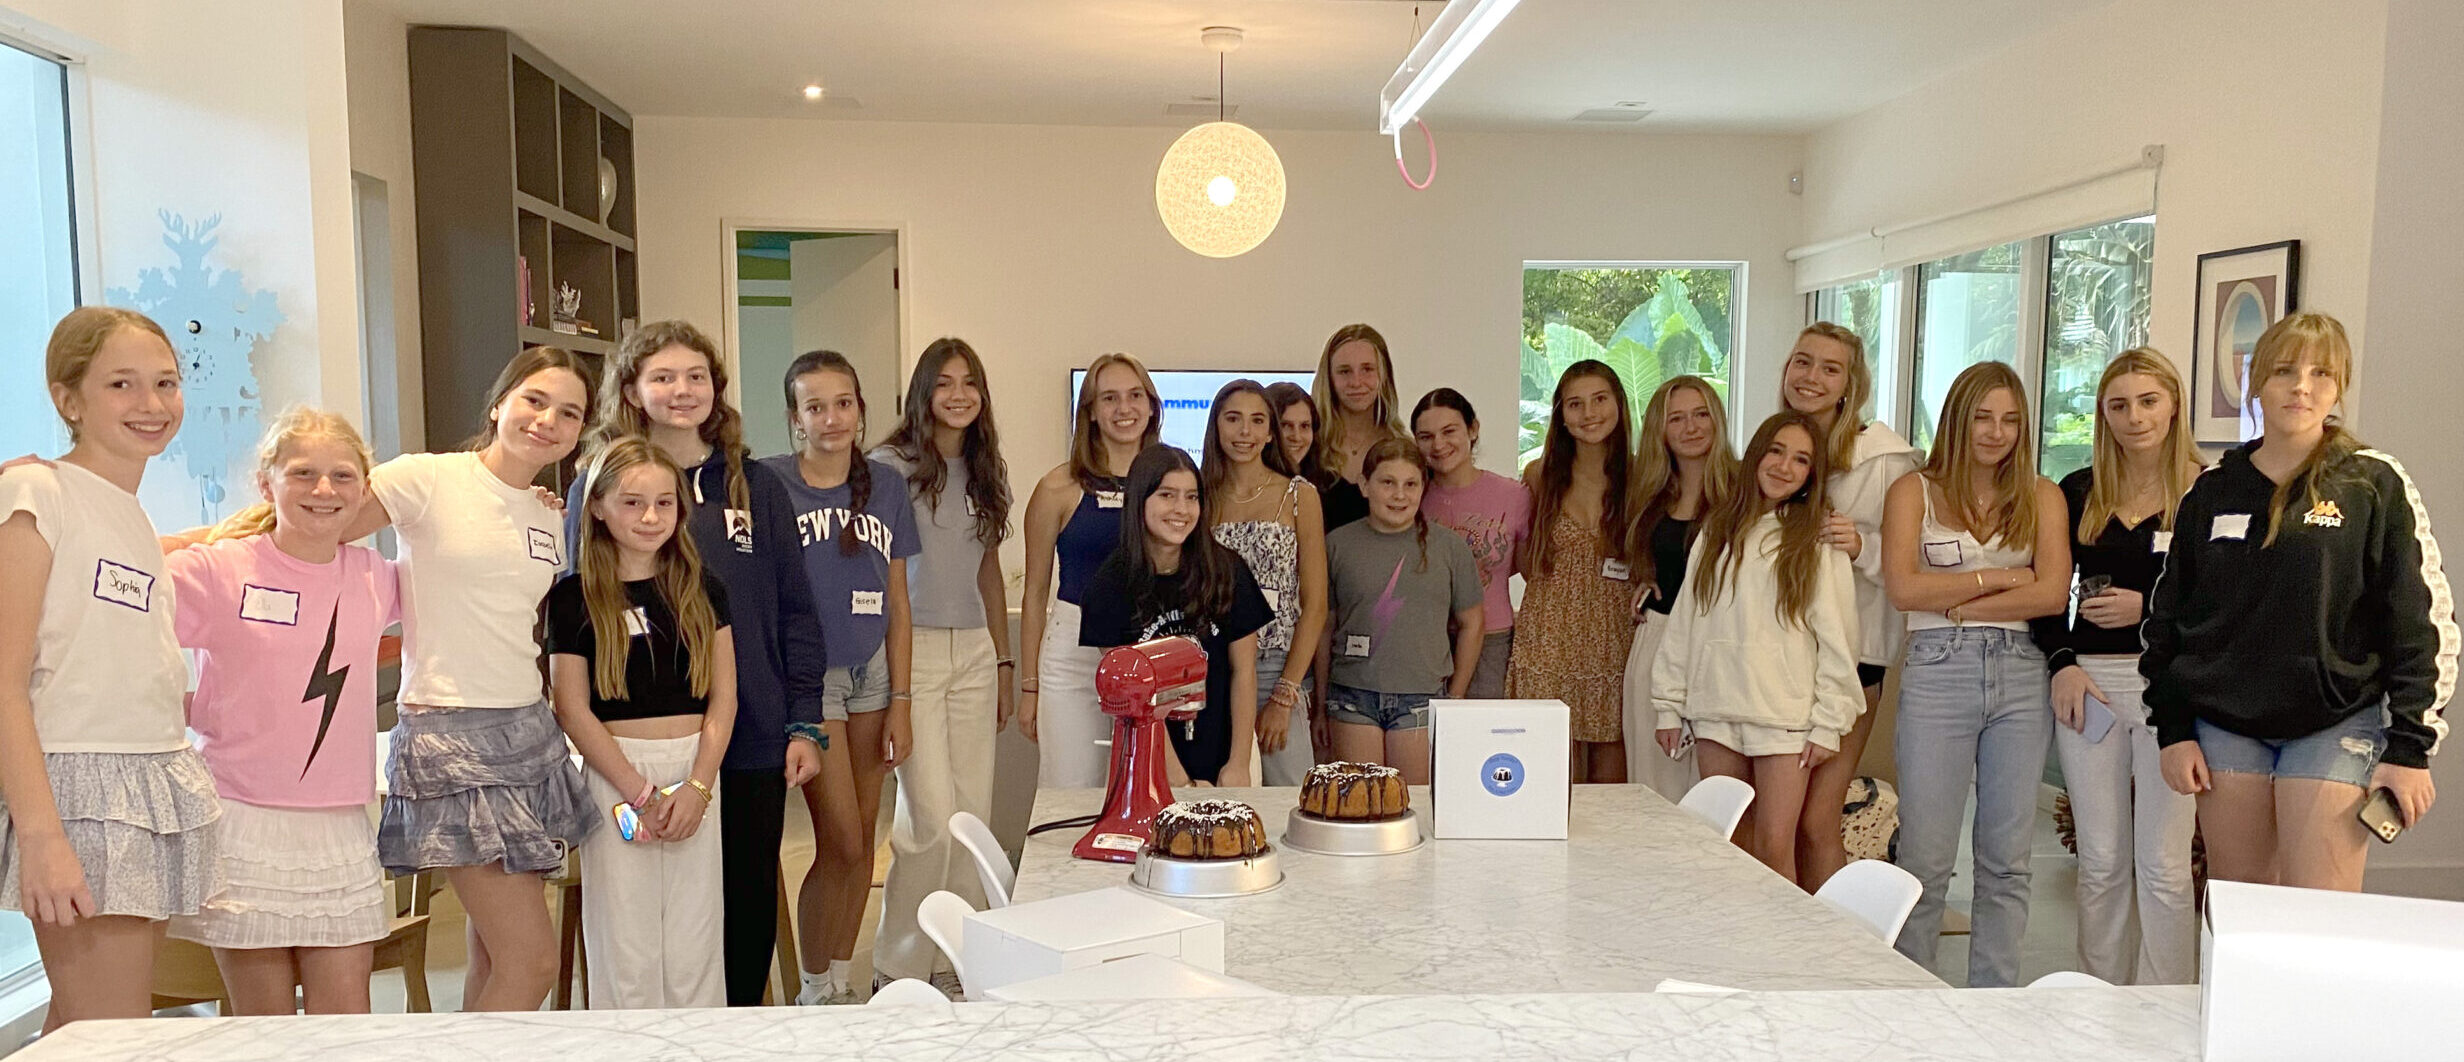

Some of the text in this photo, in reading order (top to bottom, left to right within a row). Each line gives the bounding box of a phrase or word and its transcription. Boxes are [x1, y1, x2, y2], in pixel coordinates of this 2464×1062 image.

[797, 507, 831, 547] EW
[2303, 514, 2341, 527] Kappa
[109, 569, 141, 598] Sophia
